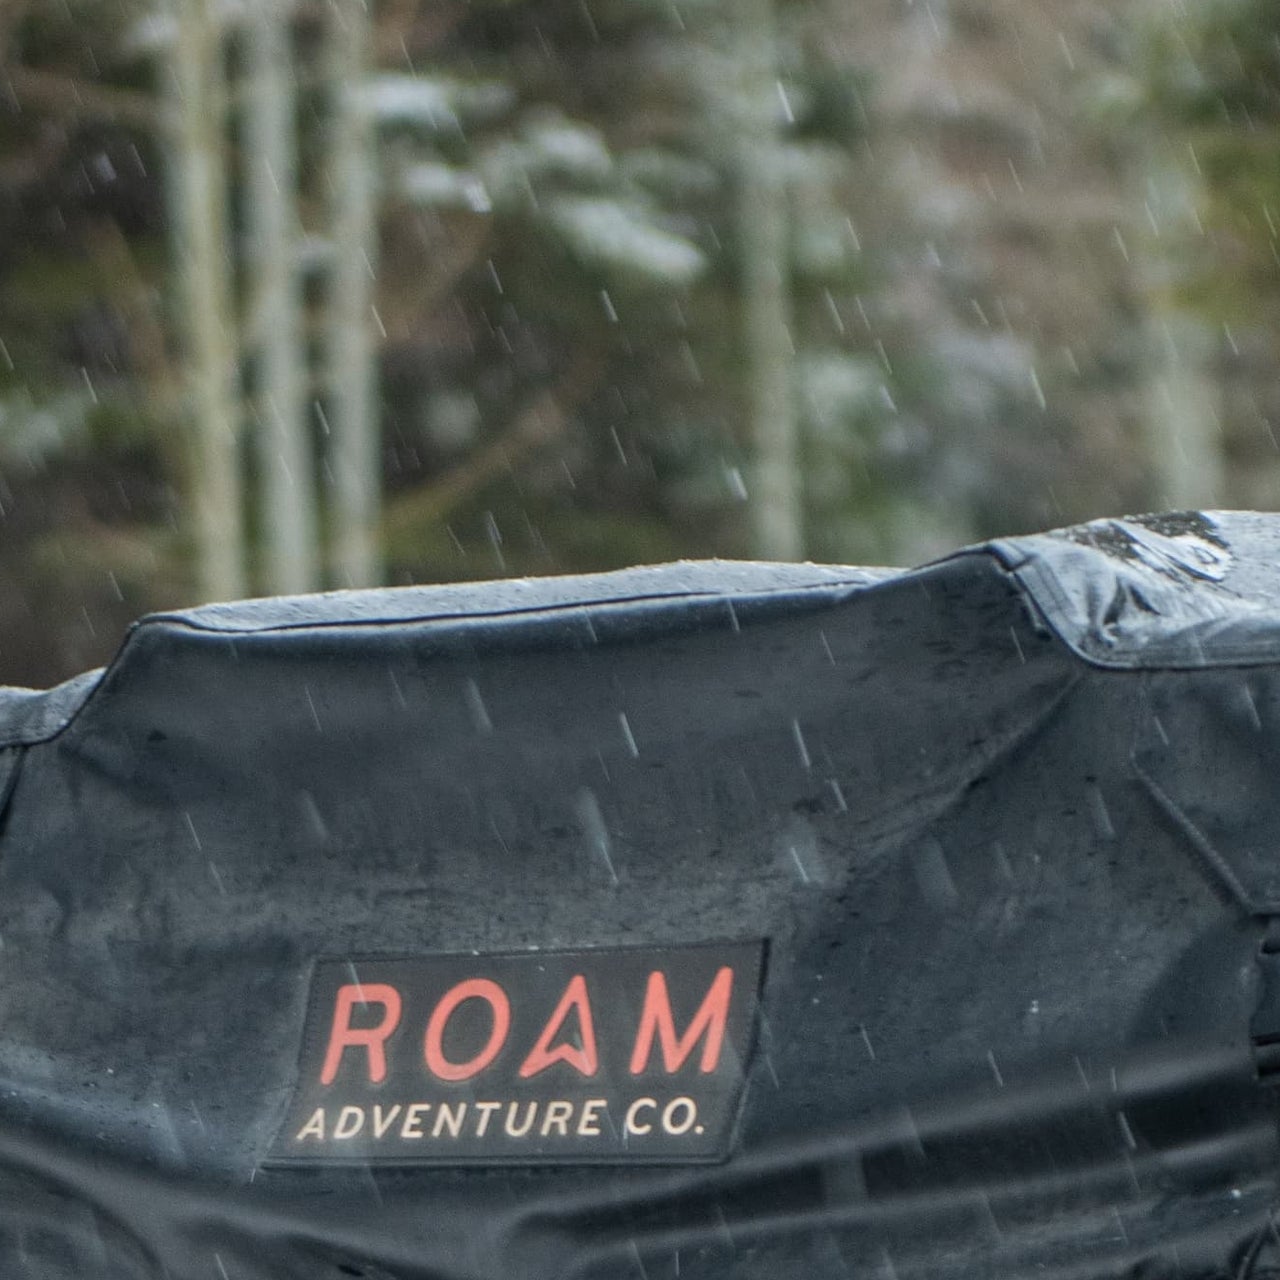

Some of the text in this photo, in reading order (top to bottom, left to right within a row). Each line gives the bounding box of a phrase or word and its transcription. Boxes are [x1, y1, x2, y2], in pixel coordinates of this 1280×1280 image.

[320, 966, 734, 1086] ROAM
[296, 1097, 706, 1141] ADVENTURE CO.
